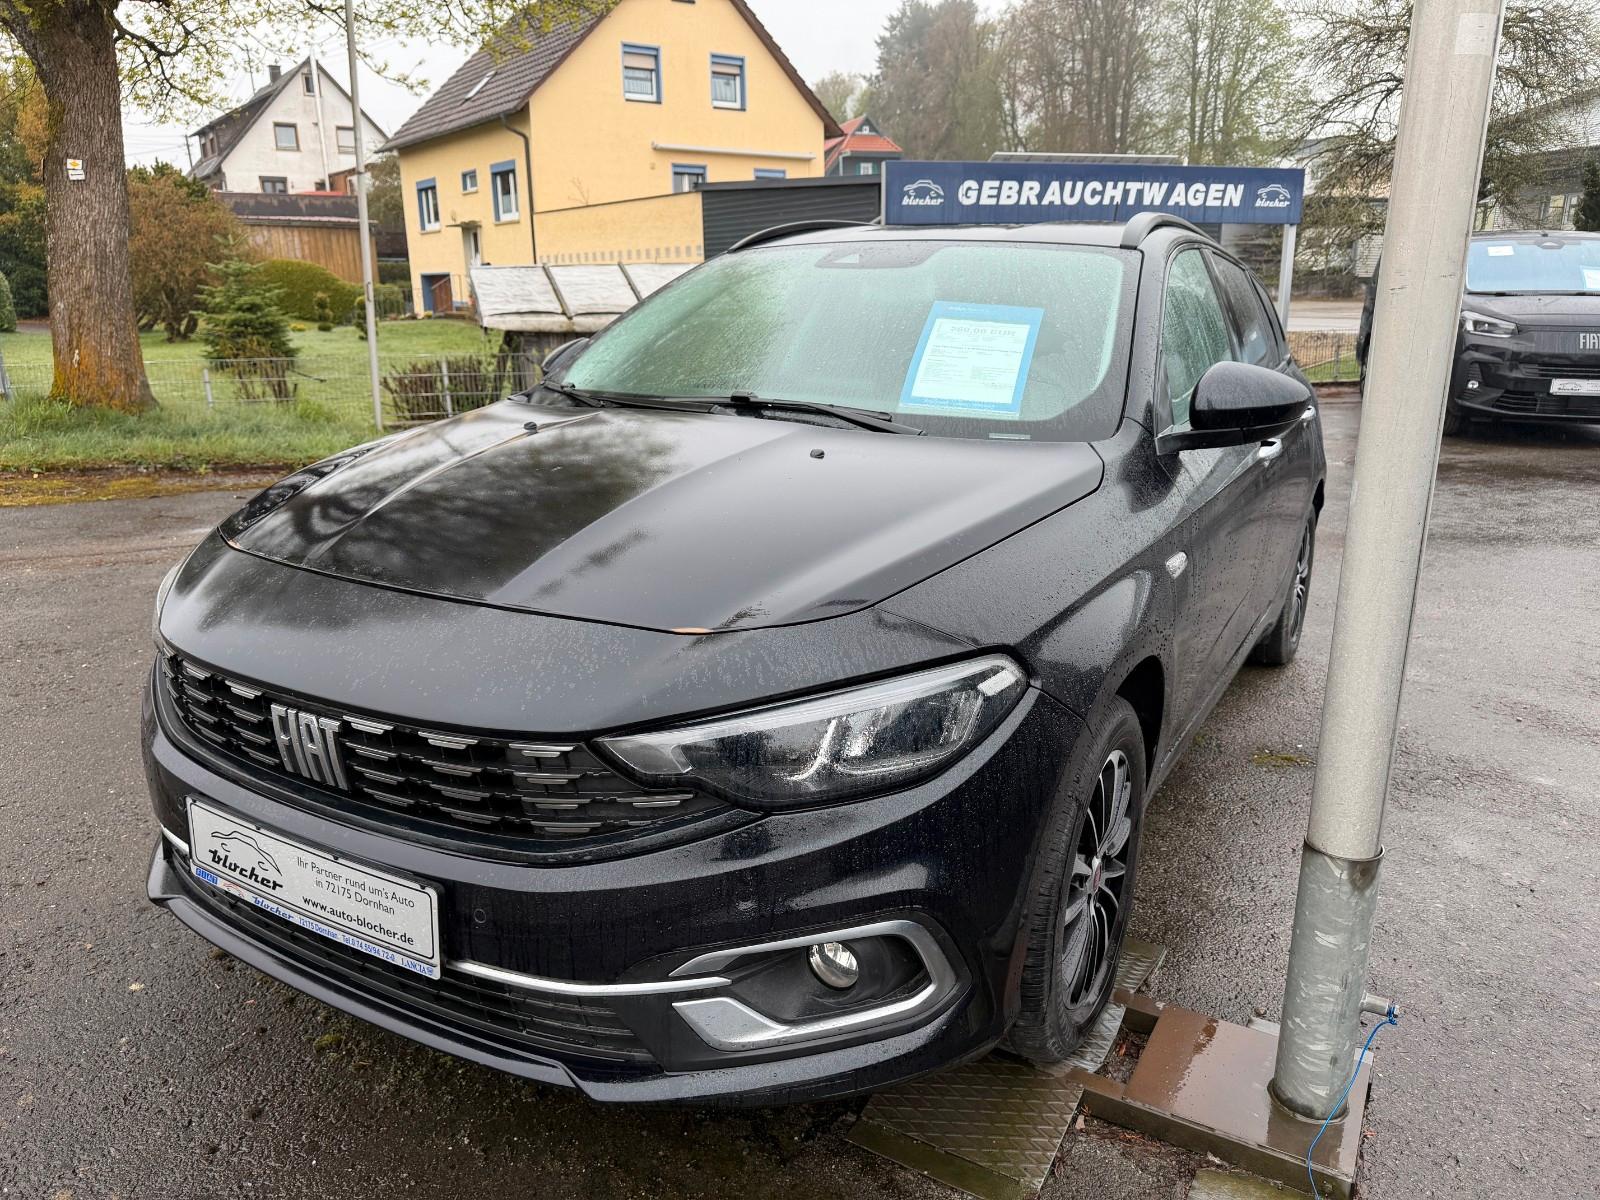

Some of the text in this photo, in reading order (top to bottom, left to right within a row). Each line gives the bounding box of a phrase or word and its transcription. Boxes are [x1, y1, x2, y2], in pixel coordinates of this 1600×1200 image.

[957, 179, 1245, 207] GEBRAUCHTWAGEN
[1579, 333, 1600, 349] FIA
[270, 703, 348, 791] FIAT
[208, 848, 284, 891] blocher
[296, 856, 415, 908] Ihr Partner rund um's Auto
[315, 876, 395, 916] in 72175 Dornhan
[302, 896, 415, 946] www.auto-blocher.de
[401, 957, 427, 975] LANCIA
